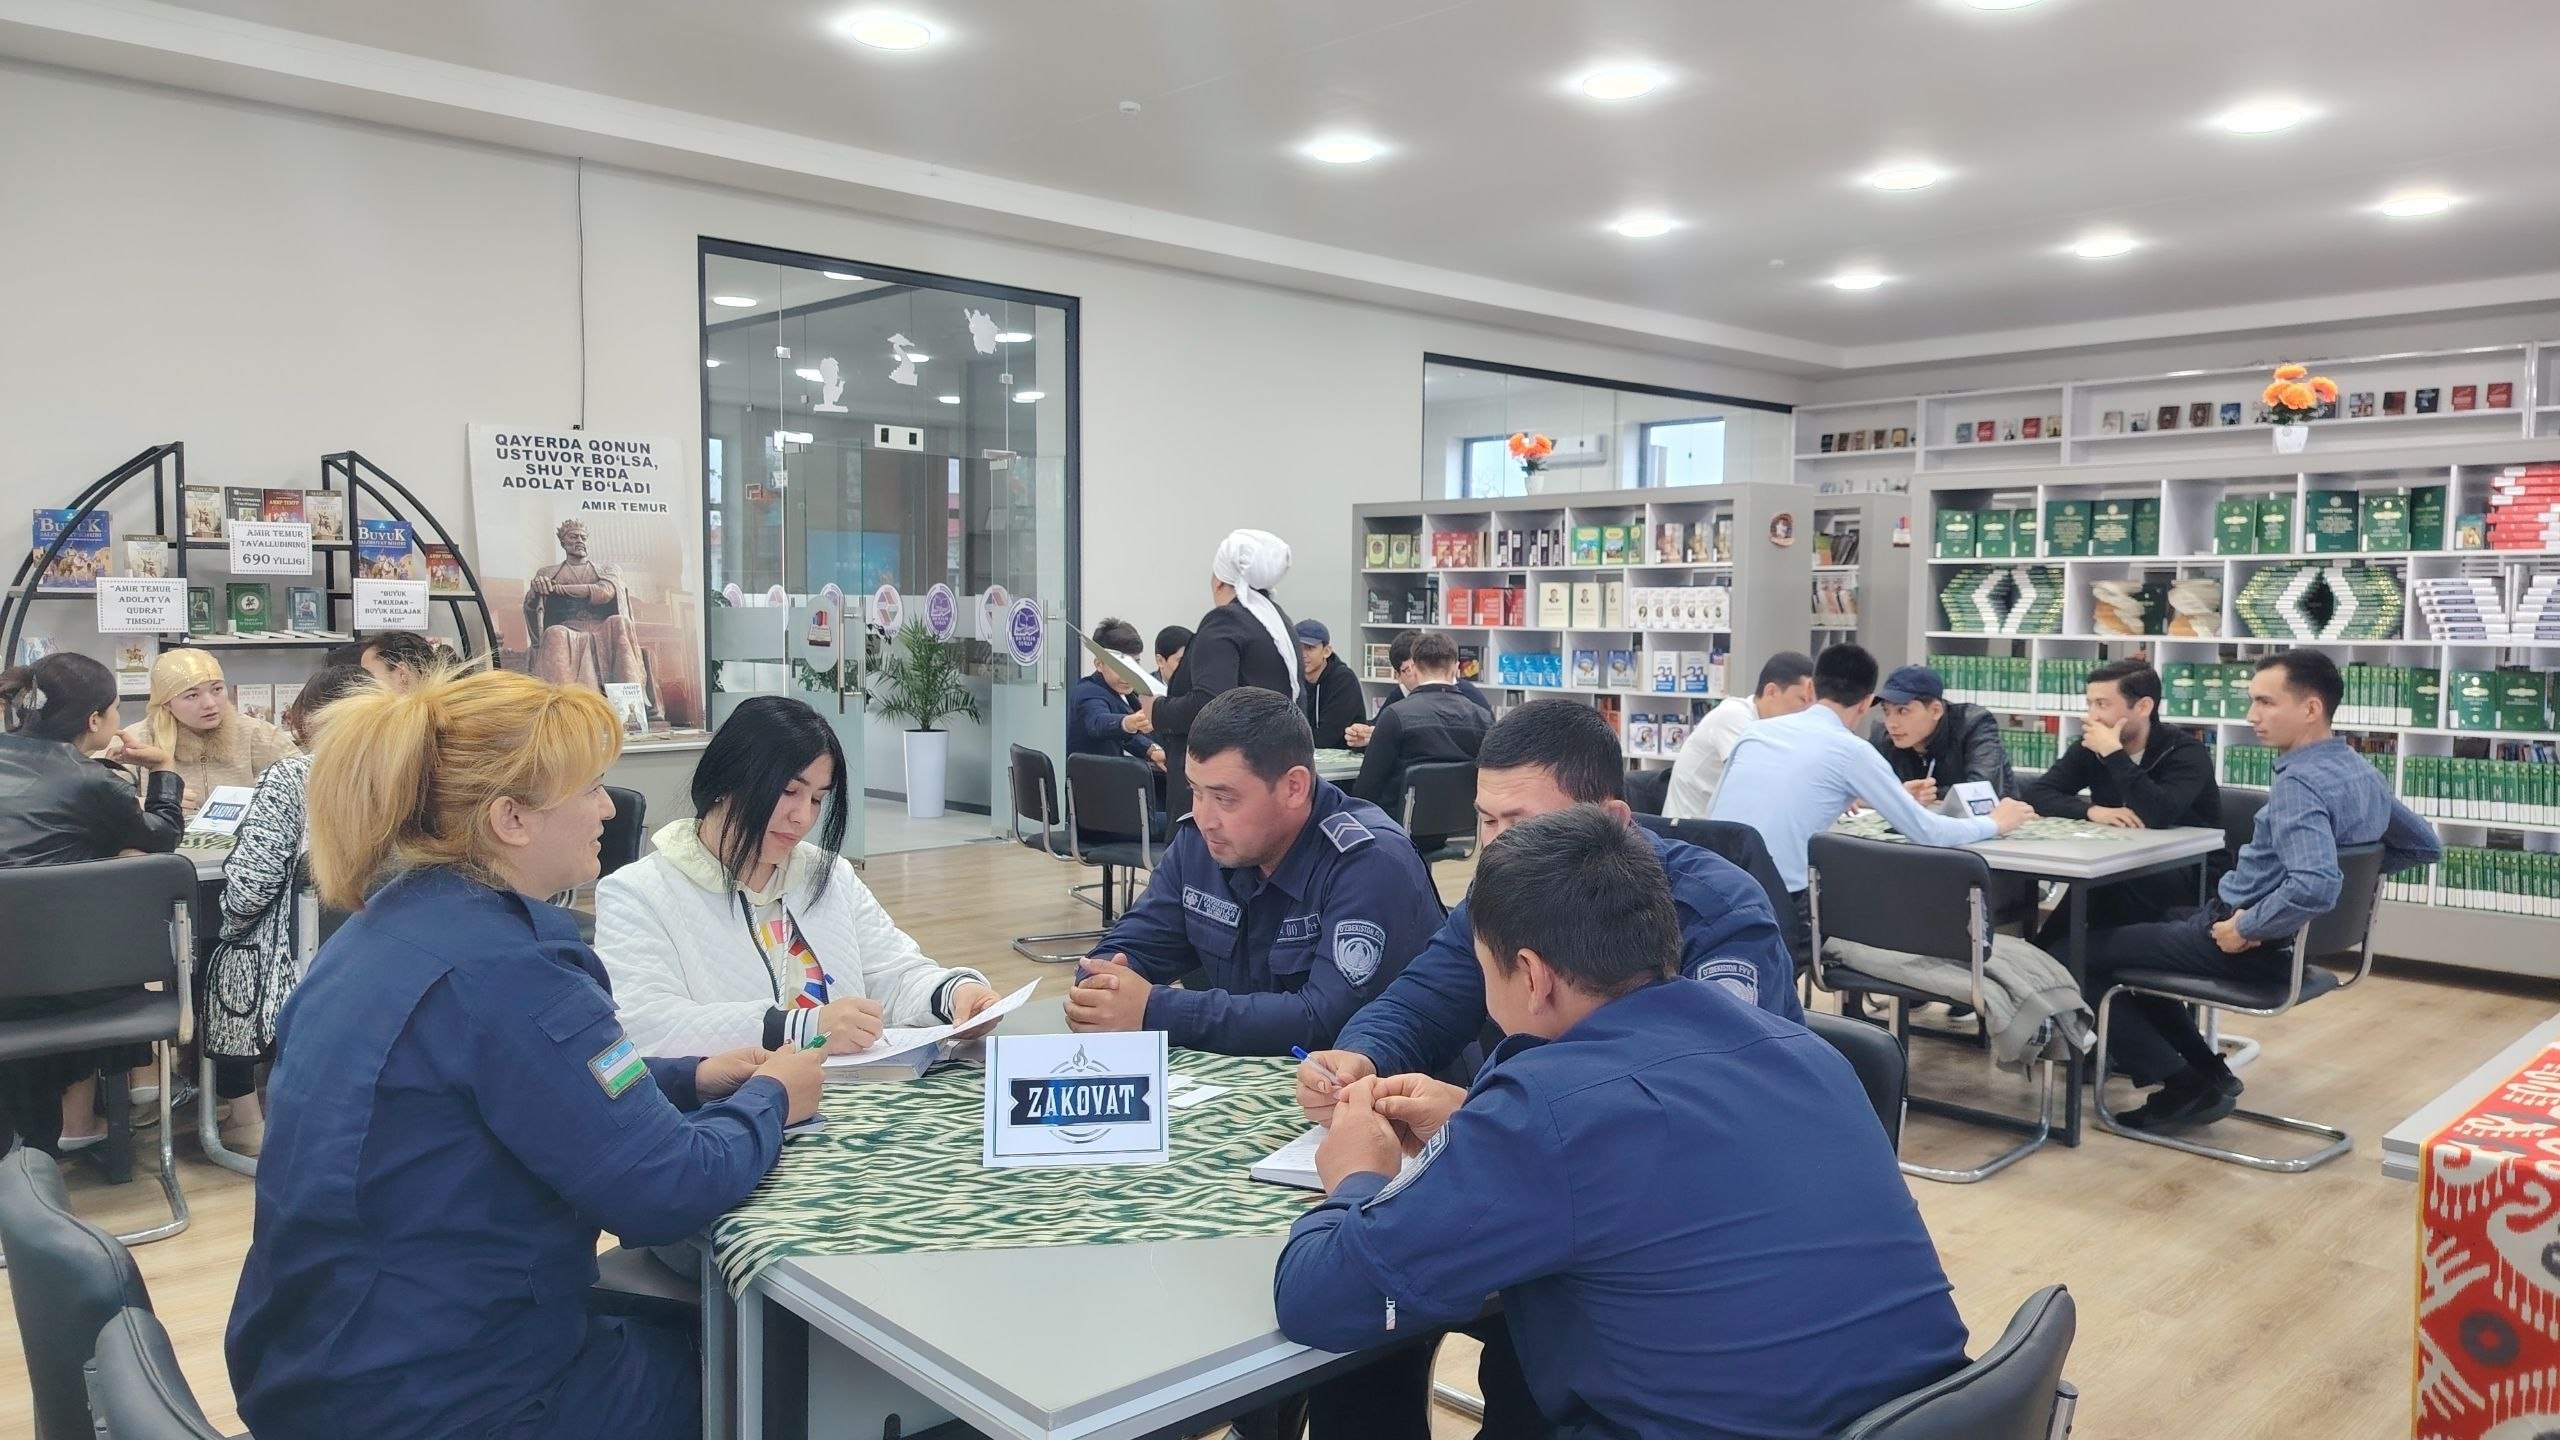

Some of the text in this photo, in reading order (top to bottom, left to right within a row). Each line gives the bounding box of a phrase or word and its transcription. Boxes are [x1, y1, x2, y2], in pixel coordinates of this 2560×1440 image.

[495, 433, 650, 455] QAYERDA QONUN
[496, 448, 658, 471] USTUVOR BO‘LSA,
[526, 463, 629, 480] SHU YERDA
[502, 476, 651, 494] ADOLAT BO‘LADI
[581, 500, 668, 513] AMIR TEMUR
[39, 518, 101, 532] BUUK
[247, 529, 304, 538] AMIR TEMUR
[240, 540, 306, 549] TAVALLUDINING
[242, 553, 271, 566] 690
[141, 585, 171, 593] TEMUR
[118, 596, 171, 604] ADOLAT VA
[127, 607, 164, 615] QUDRAT
[1026, 1084, 1135, 1118] ZAKOVAT
